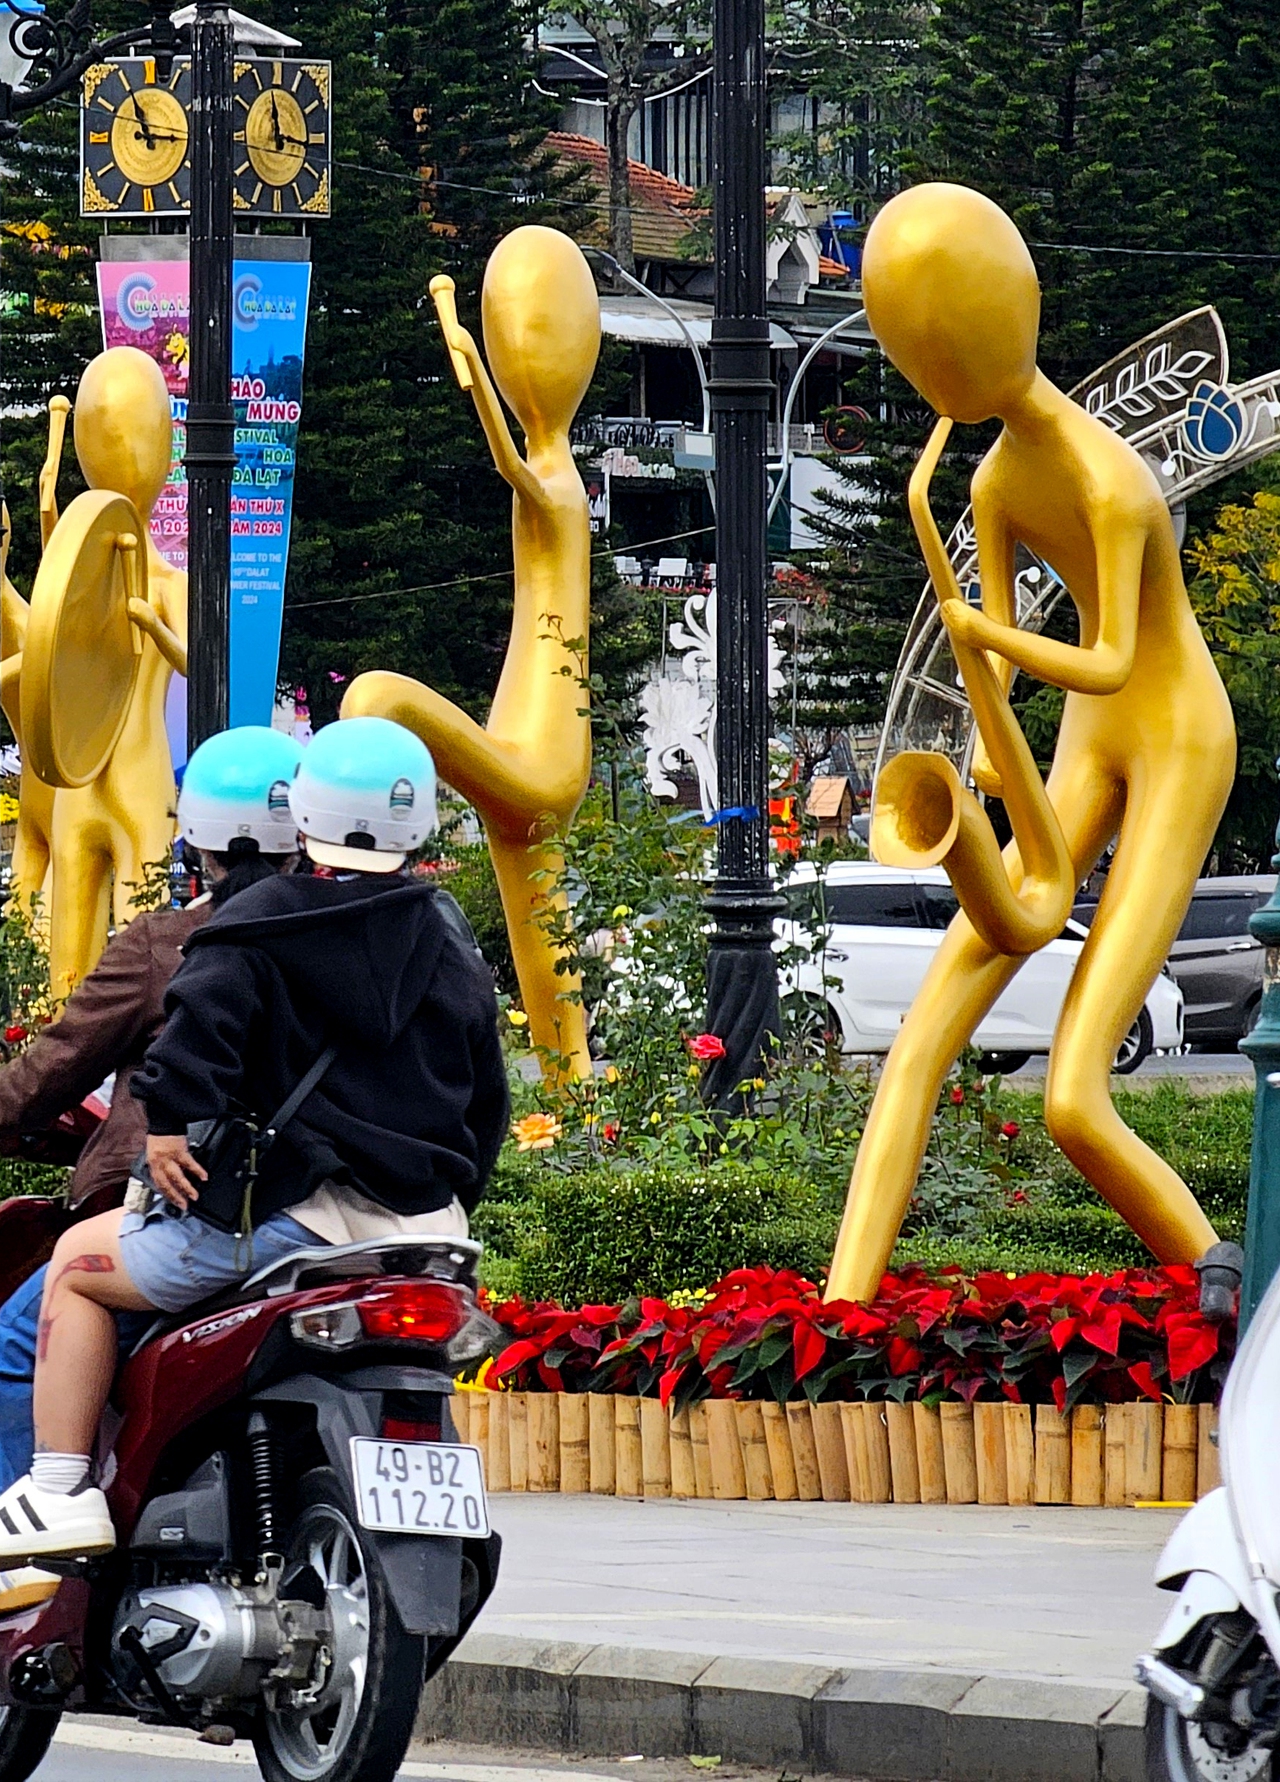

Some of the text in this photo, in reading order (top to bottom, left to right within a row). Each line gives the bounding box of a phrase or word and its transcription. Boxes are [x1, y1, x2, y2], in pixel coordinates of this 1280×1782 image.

[231, 376, 263, 398] HÀO
[236, 429, 278, 444] STIVAL
[264, 449, 292, 463] HOA
[257, 470, 280, 488] LẠT
[274, 500, 284, 512] X
[165, 521, 189, 533] 202
[232, 518, 282, 534] ĂM 2024
[232, 553, 256, 563] LCOME
[376, 1446, 463, 1488] 49-B2
[368, 1487, 481, 1530] 112.20
